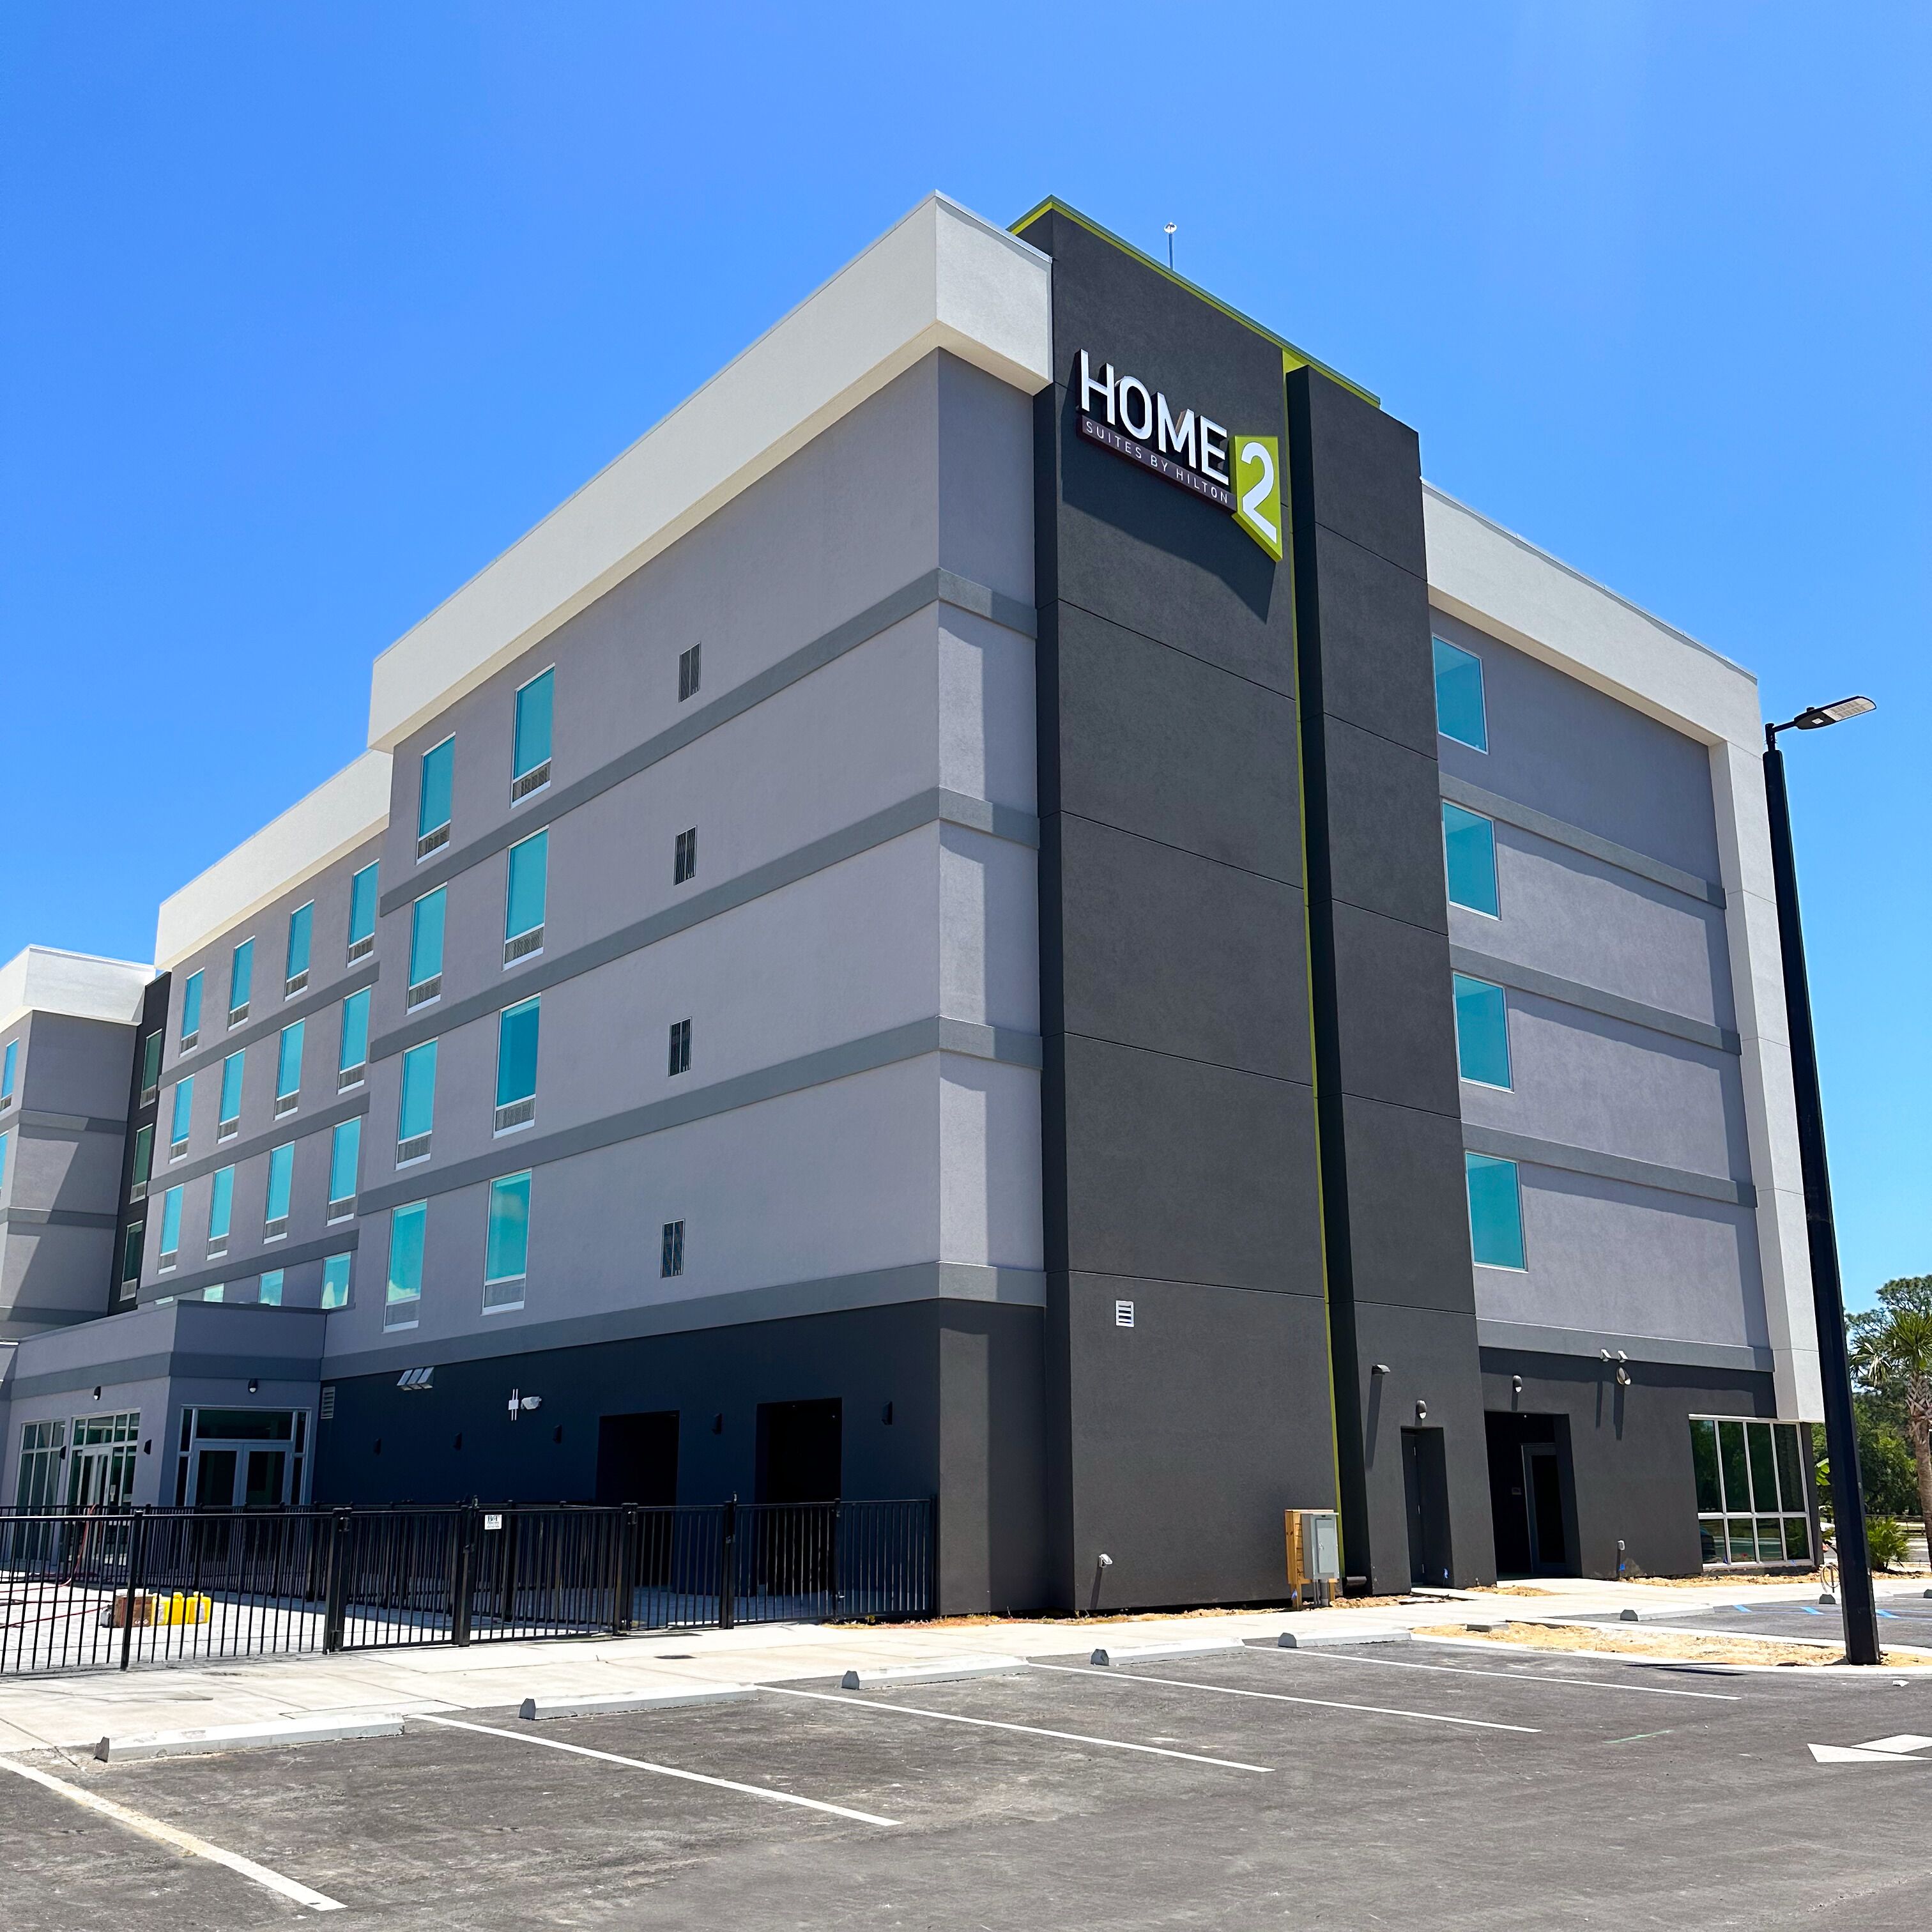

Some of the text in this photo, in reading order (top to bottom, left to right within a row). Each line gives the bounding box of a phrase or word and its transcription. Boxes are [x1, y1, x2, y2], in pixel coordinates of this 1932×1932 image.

[1080, 348, 1277, 544] HOME 2
[1086, 421, 1228, 503] SUITES BY HILTON
